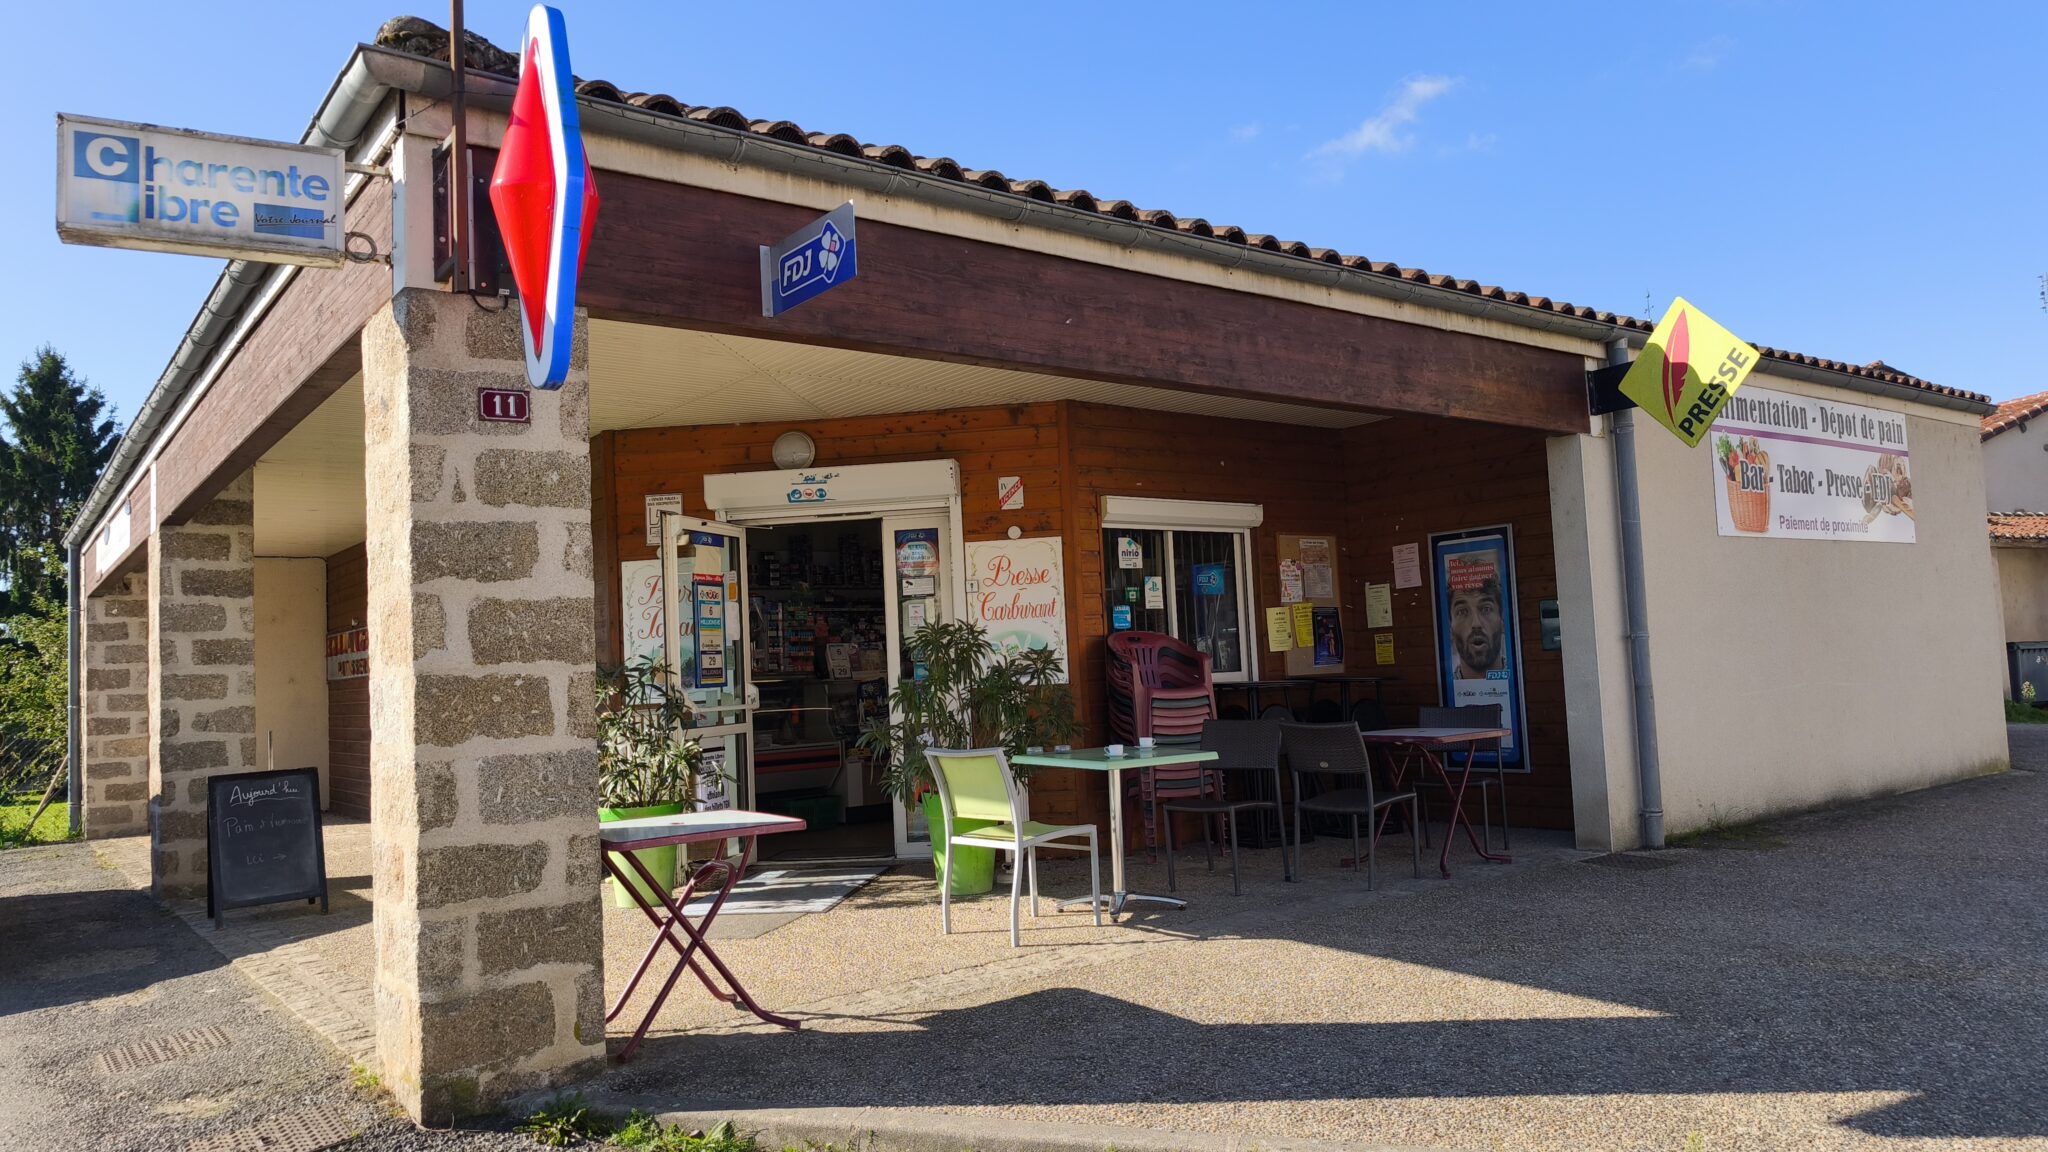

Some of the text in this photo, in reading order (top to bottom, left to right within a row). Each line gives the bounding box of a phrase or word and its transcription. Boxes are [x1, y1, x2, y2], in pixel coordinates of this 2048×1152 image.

[85, 136, 330, 202] Charente
[255, 213, 336, 224] Votre Journal
[783, 248, 812, 287] FDJ
[493, 395, 517, 417] 11
[1678, 347, 1750, 438] PRESSE
[1820, 405, 1857, 438] Dépot
[1860, 414, 1874, 440] de
[1878, 418, 1904, 445] pain
[1740, 462, 1765, 491] Bar
[1777, 464, 1815, 495] Tabac
[1825, 468, 1862, 499] Presse
[1873, 474, 1892, 504] FDJ
[1779, 515, 1868, 535] Paiement de proximité
[983, 555, 1049, 587] Presse
[977, 591, 1057, 621] Carburant
[709, 656, 717, 666] 29
[1487, 671, 1501, 679] FDJ
